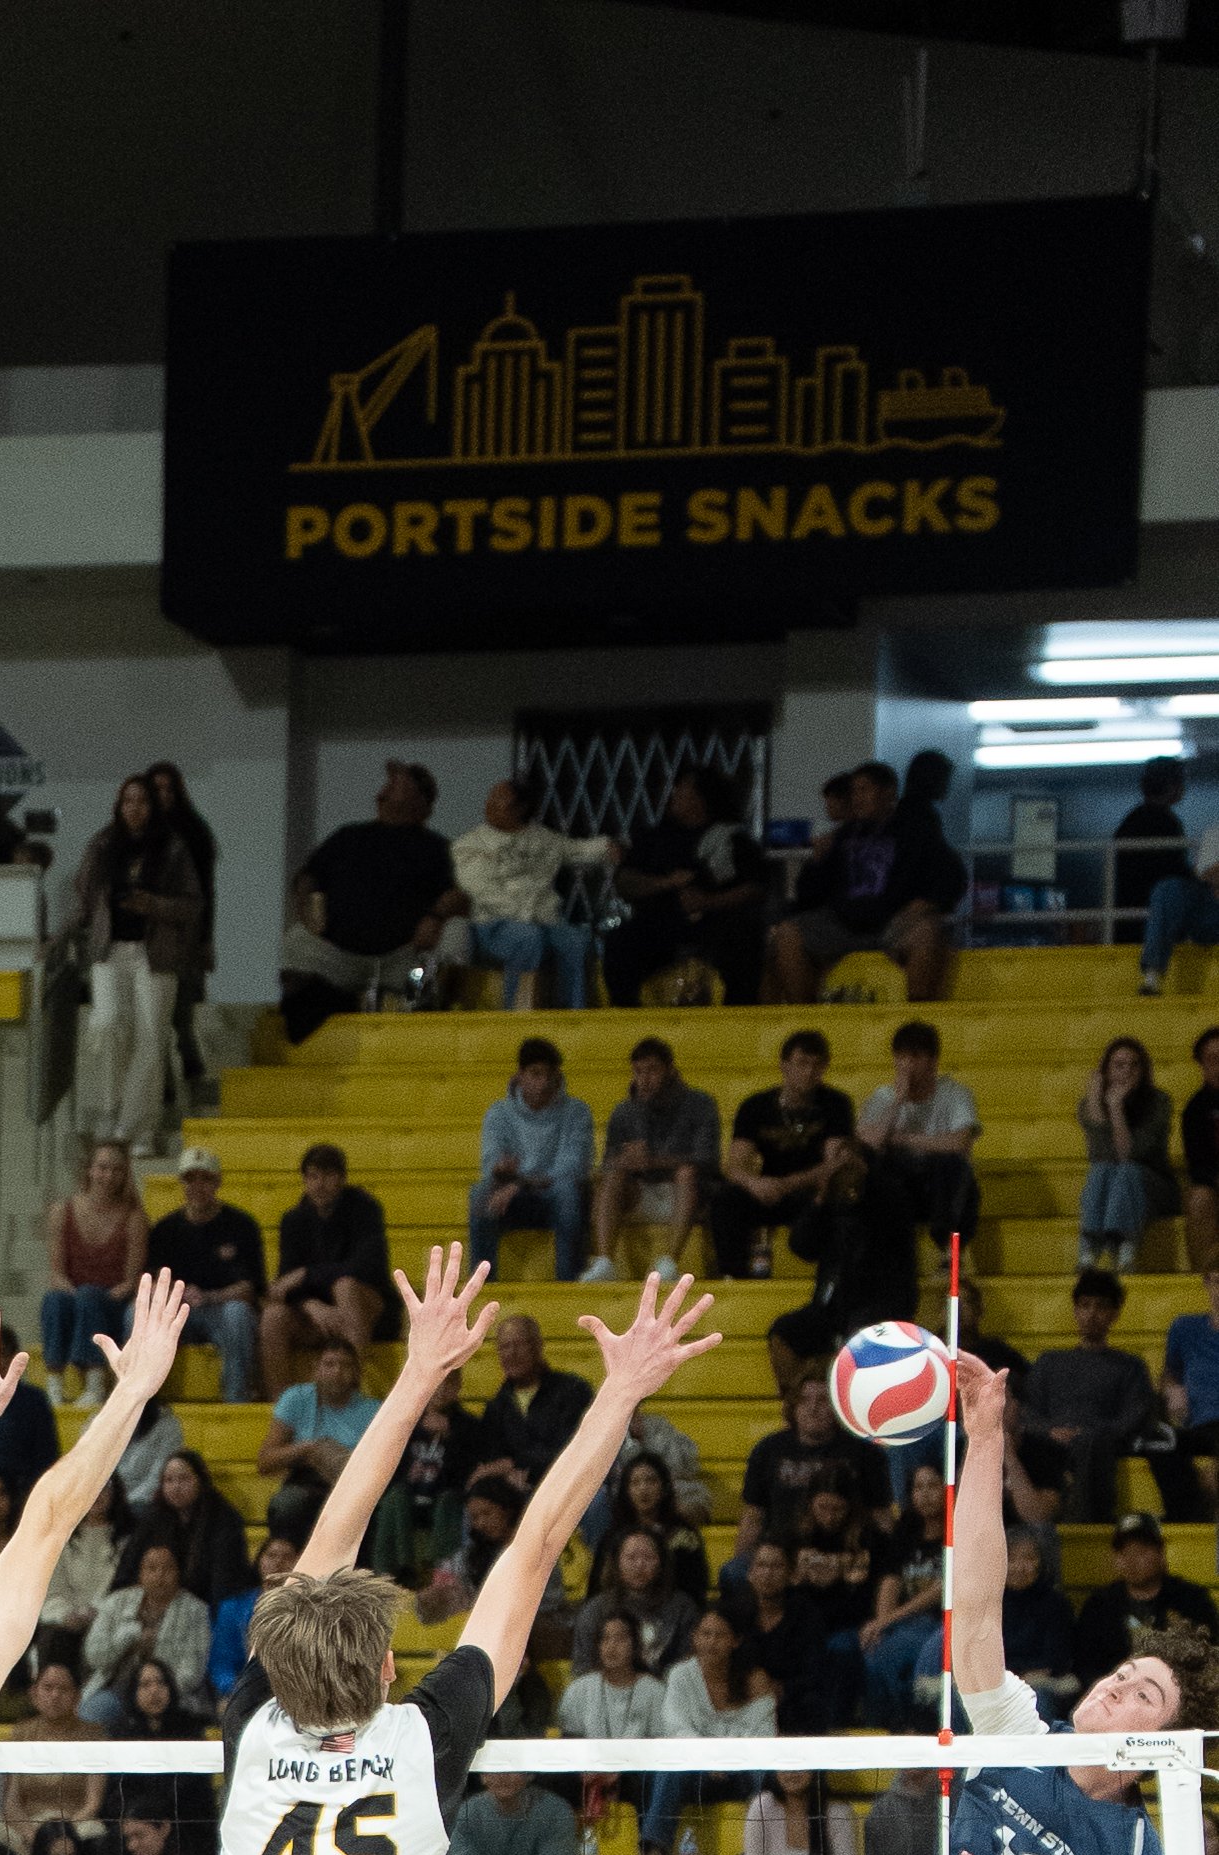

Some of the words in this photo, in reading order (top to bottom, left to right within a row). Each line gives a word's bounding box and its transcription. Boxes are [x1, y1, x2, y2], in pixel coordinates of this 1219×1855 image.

[285, 491, 663, 560] PORTSIDE
[686, 476, 1000, 544] SNACKS
[1137, 1738, 1175, 1747] Senoh
[267, 1757, 321, 1784] LONG
[328, 1754, 395, 1783] BEACH
[991, 1786, 1045, 1836] PENN
